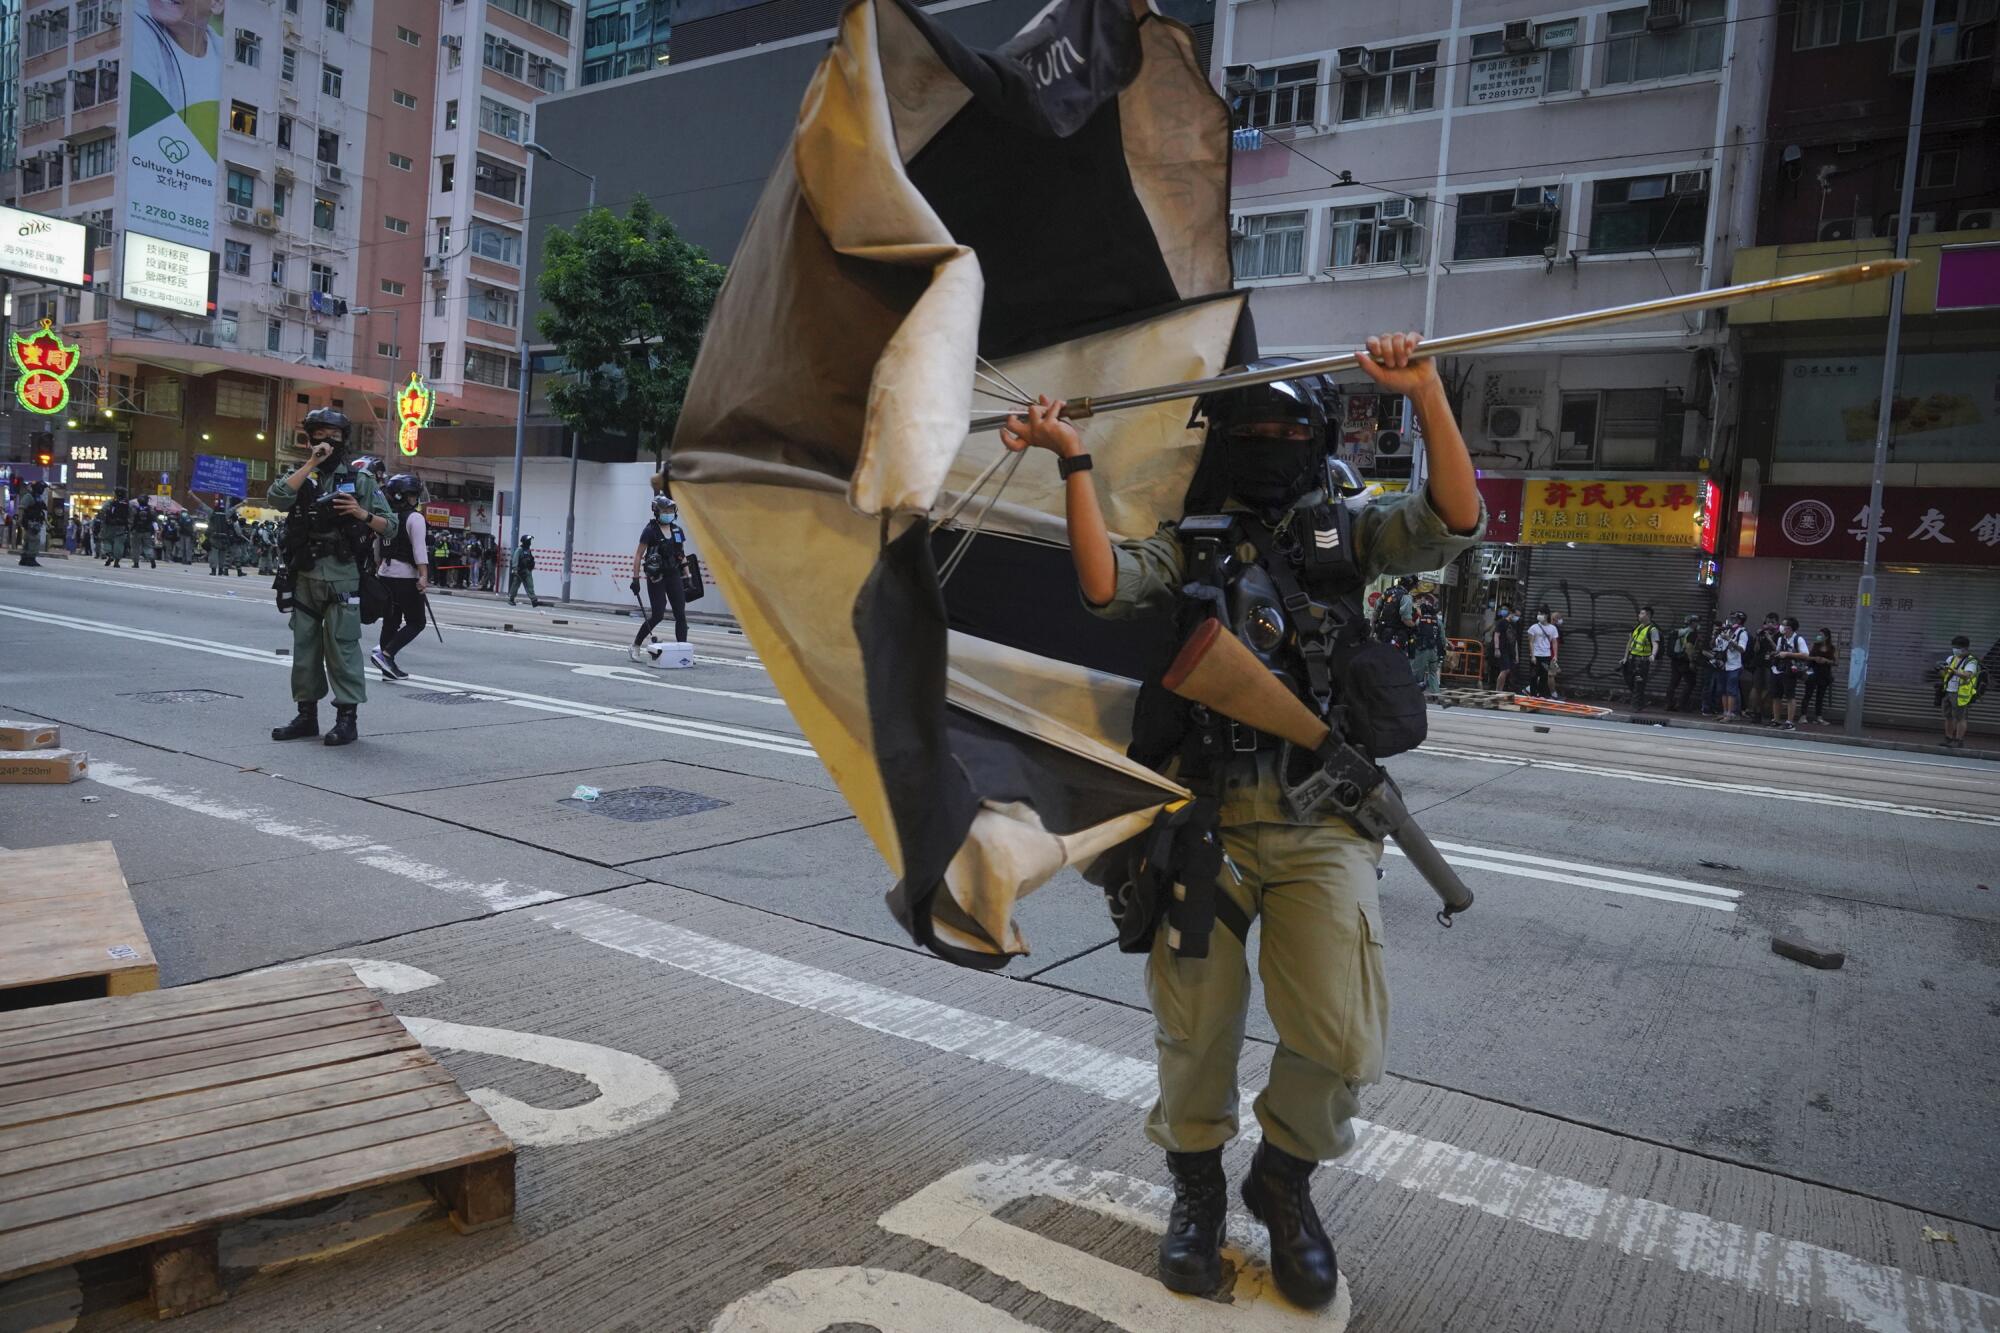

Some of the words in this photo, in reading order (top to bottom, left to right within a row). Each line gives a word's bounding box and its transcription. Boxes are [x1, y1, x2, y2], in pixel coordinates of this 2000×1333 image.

[1487, 86, 1536, 99] 28919773
[131, 156, 173, 175] Culture
[176, 169, 213, 187] Homes
[157, 174, 189, 191] 文化村
[132, 201, 143, 213] T.
[145, 205, 176, 221] 2780
[180, 214, 209, 230] 3882
[5, 245, 65, 265] 海外移民專家
[146, 244, 189, 262] 技術移民
[146, 257, 189, 276] 投資移民
[25, 374, 61, 409] 押
[1544, 482, 1695, 511] 許氏兄弟
[1530, 529, 1589, 539] EXCHANGE
[1600, 532, 1620, 542] AND
[1628, 533, 1694, 545] REMITTANC
[22, 767, 52, 776] 250ml
